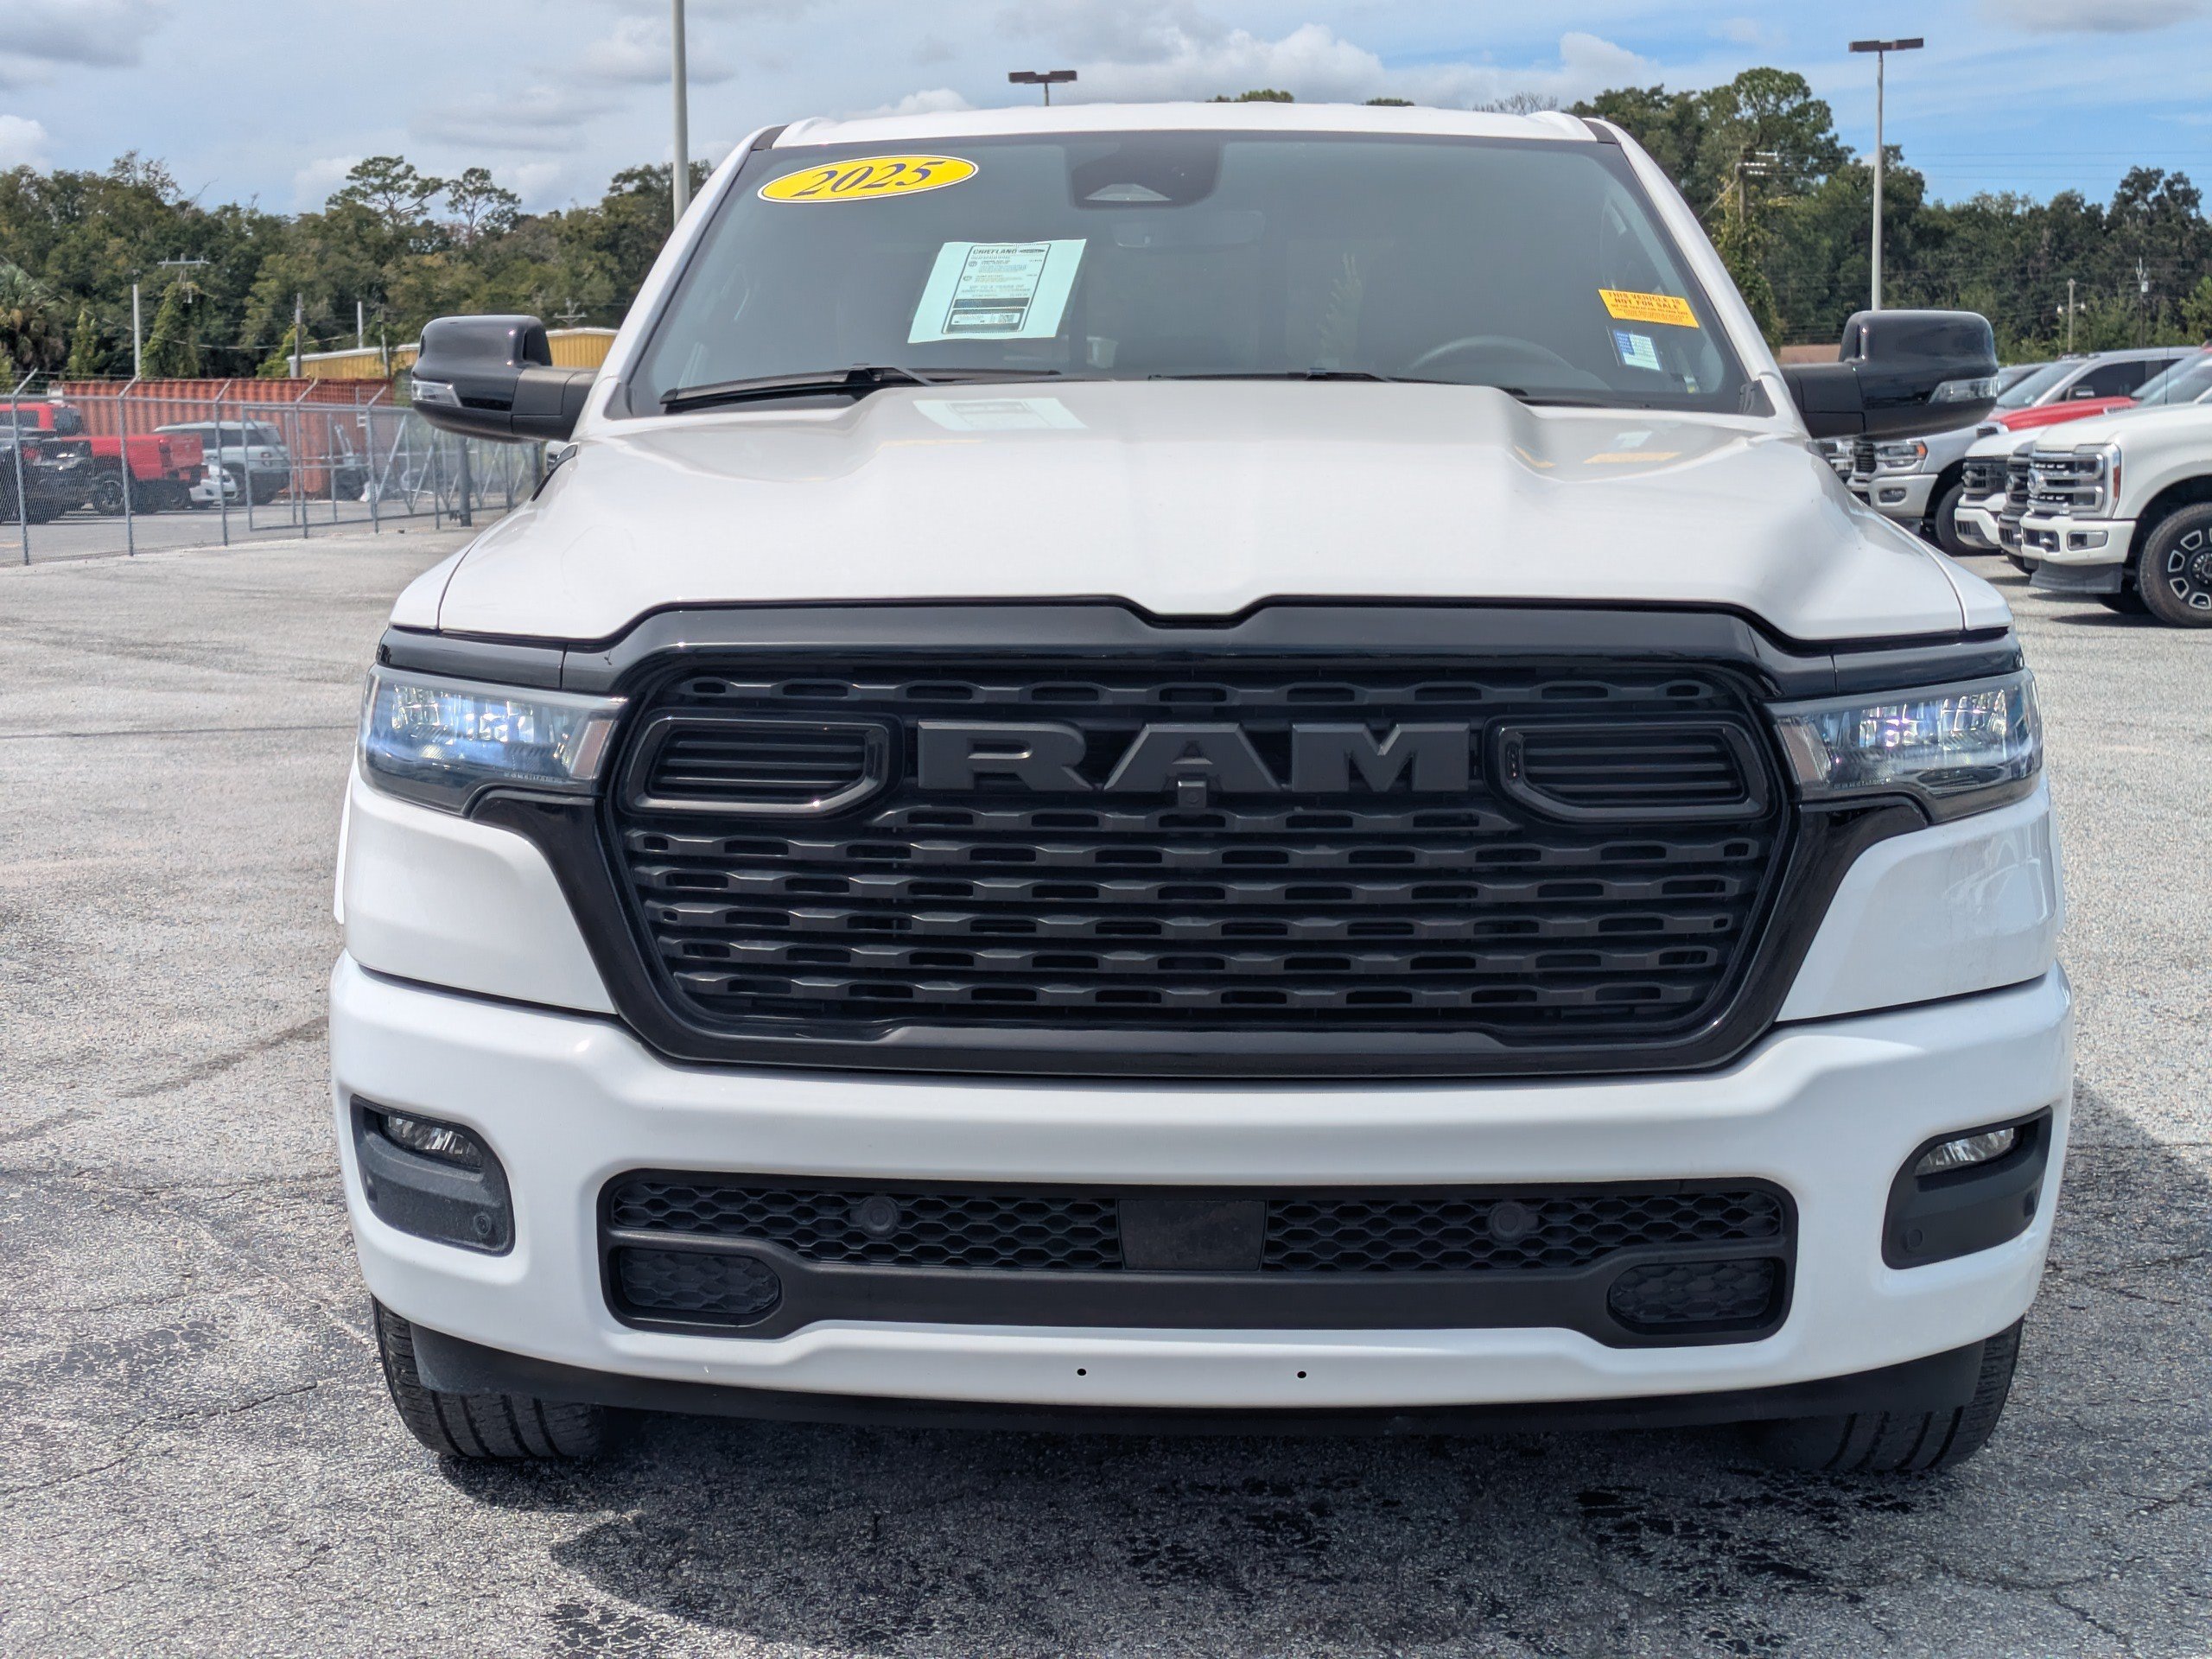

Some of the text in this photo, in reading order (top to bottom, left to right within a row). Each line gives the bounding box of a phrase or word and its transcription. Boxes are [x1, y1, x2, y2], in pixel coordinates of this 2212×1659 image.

[791, 161, 946, 197] 2025
[1631, 294, 1668, 302] VEHICLE
[918, 719, 1470, 791] RAM
